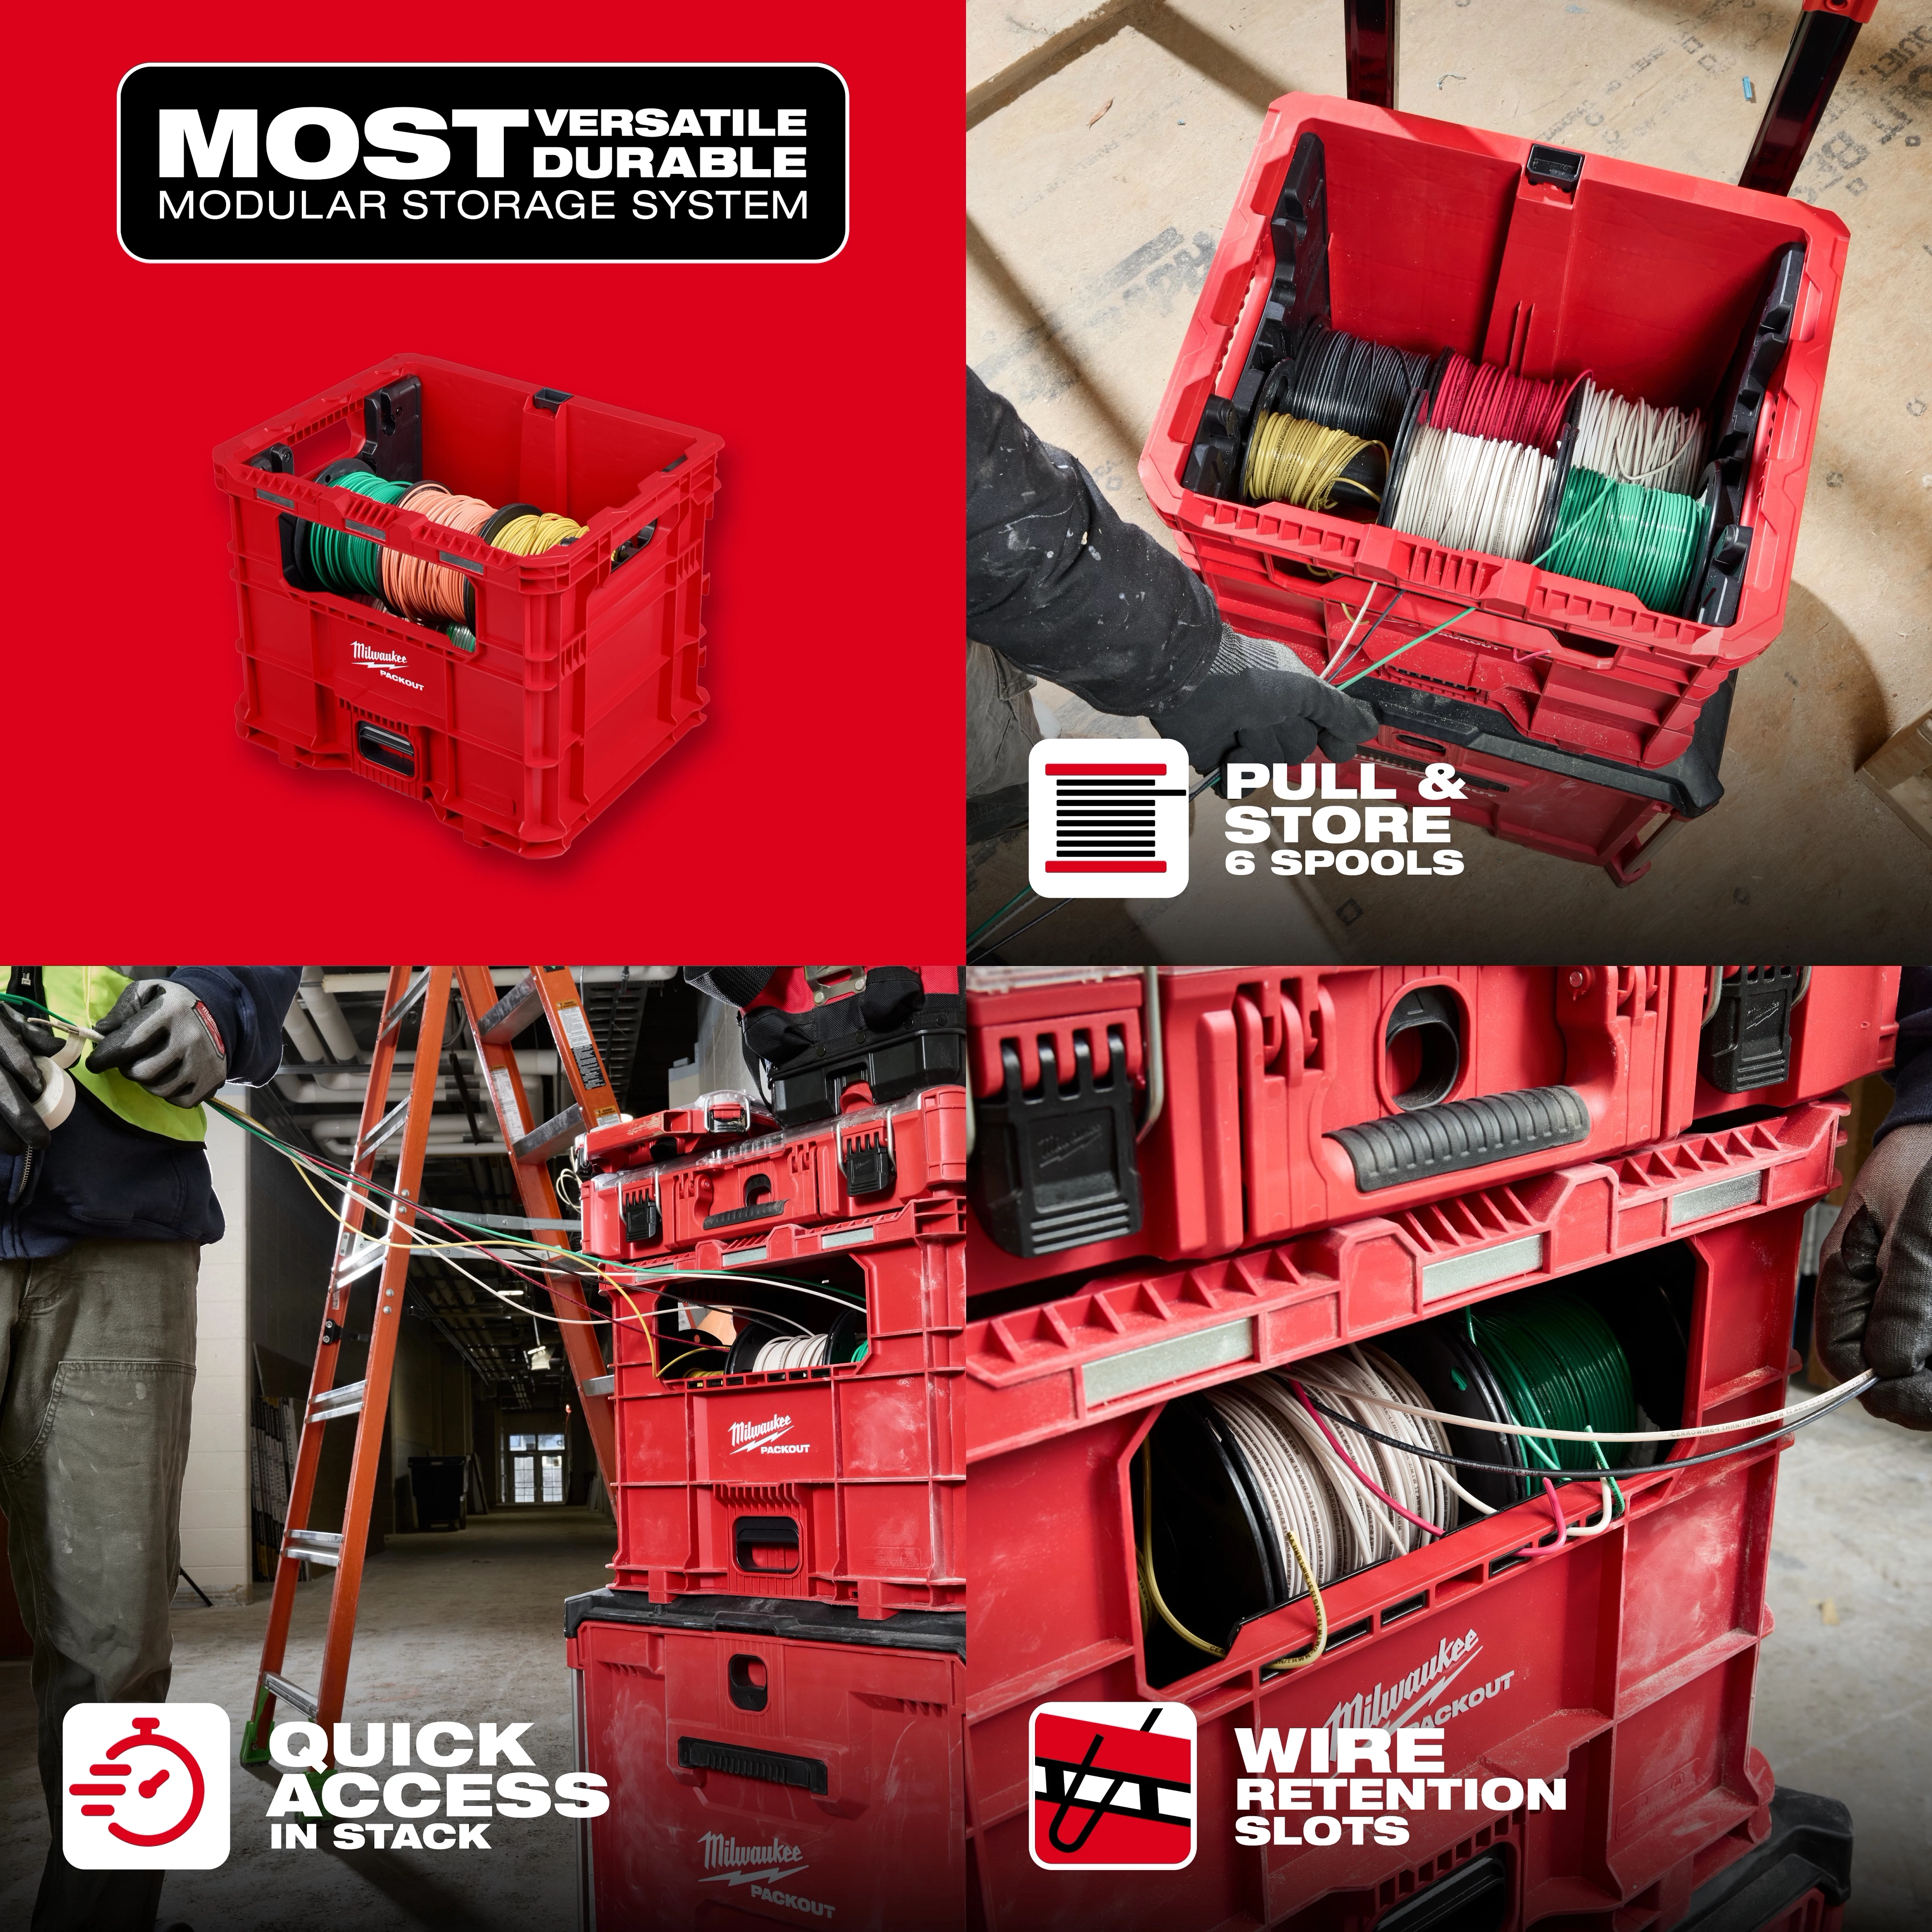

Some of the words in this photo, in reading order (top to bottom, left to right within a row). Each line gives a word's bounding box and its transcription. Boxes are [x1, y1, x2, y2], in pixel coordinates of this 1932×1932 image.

[350, 641, 408, 663] Milwaukee
[380, 670, 424, 691] PACKOUT
[728, 1414, 792, 1447] Milwaukee
[761, 1444, 810, 1454] PACKOUT
[1281, 1429, 1290, 1438] OR
[1288, 1439, 1301, 1455] AWM
[1382, 1436, 1398, 1447] AWG
[1298, 1474, 1308, 1491] AWG
[1415, 1486, 1420, 1494] 12
[1275, 1499, 1283, 1516] AWG
[1313, 1599, 1322, 1616] AWG
[1317, 1619, 1322, 1627] 12
[1323, 1628, 1479, 1762] Milwaukee
[697, 1831, 803, 1870] Milwaukee
[751, 1885, 835, 1918] PACKOUT
